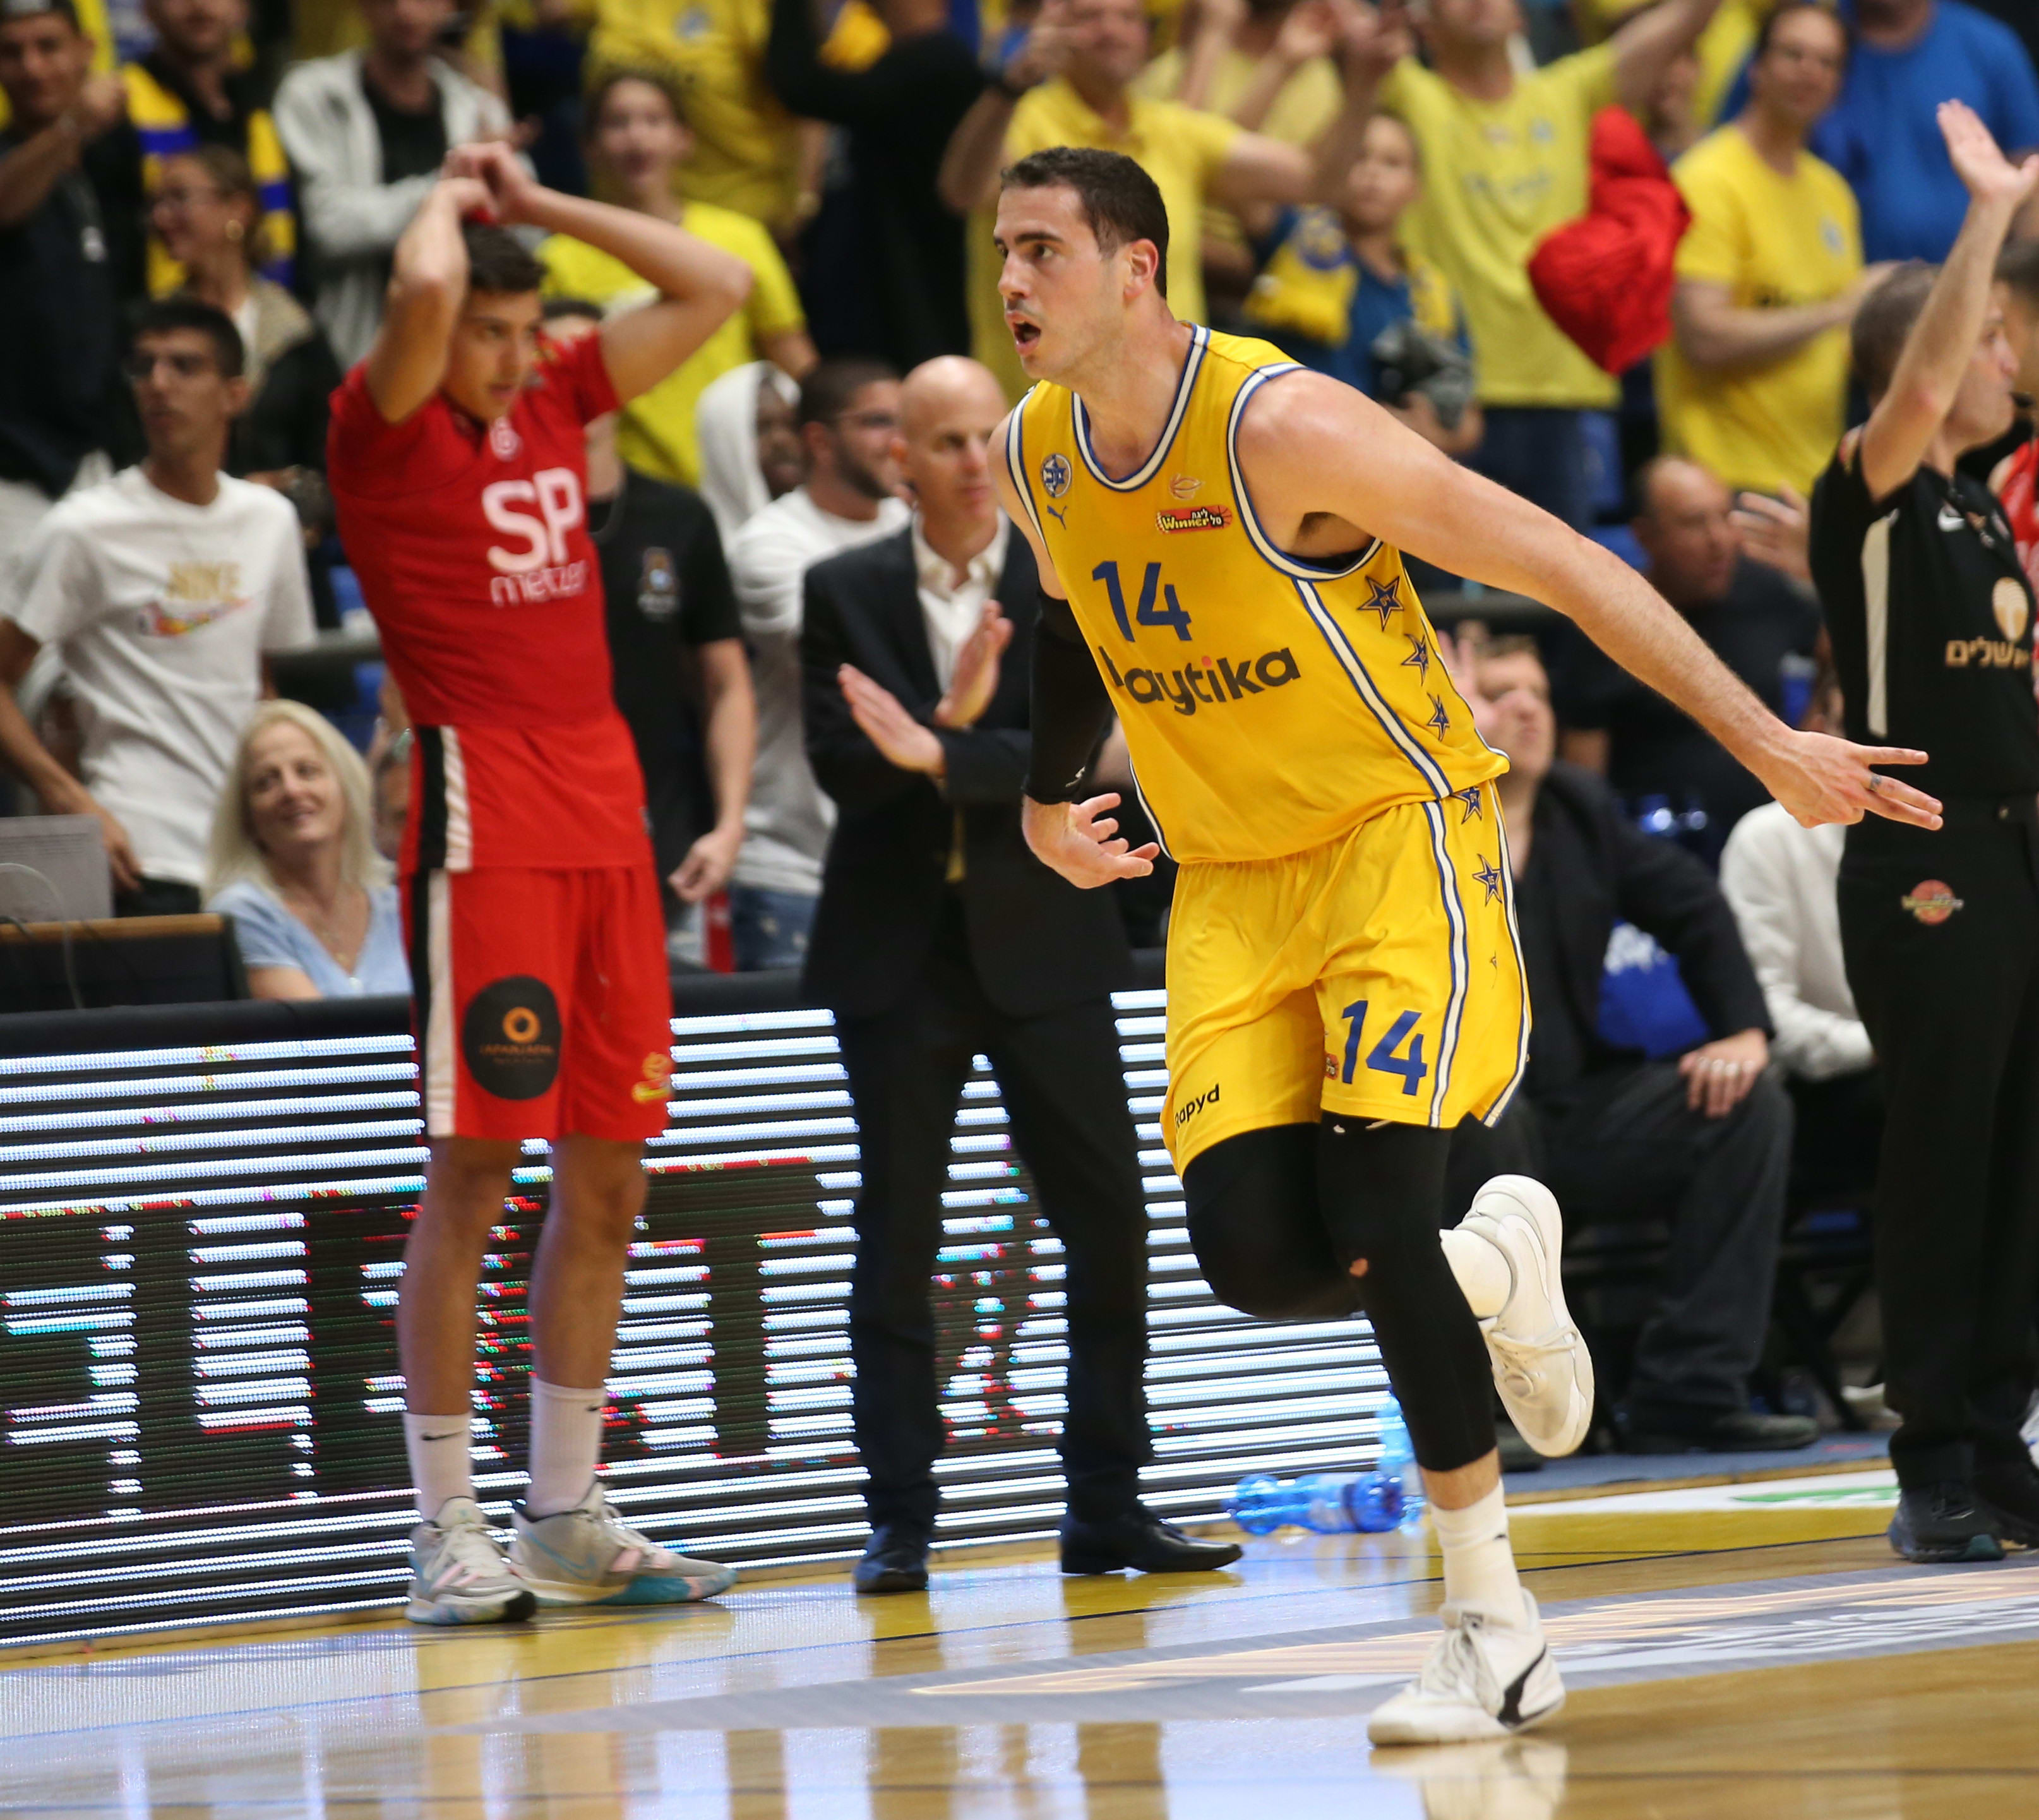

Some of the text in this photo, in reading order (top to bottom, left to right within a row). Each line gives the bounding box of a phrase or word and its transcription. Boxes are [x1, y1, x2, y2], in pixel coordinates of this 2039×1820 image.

[481, 466, 583, 574] SP
[1161, 515, 1210, 530] Winner
[1092, 560, 1192, 642] 14
[1341, 1000, 1428, 1096] 14
